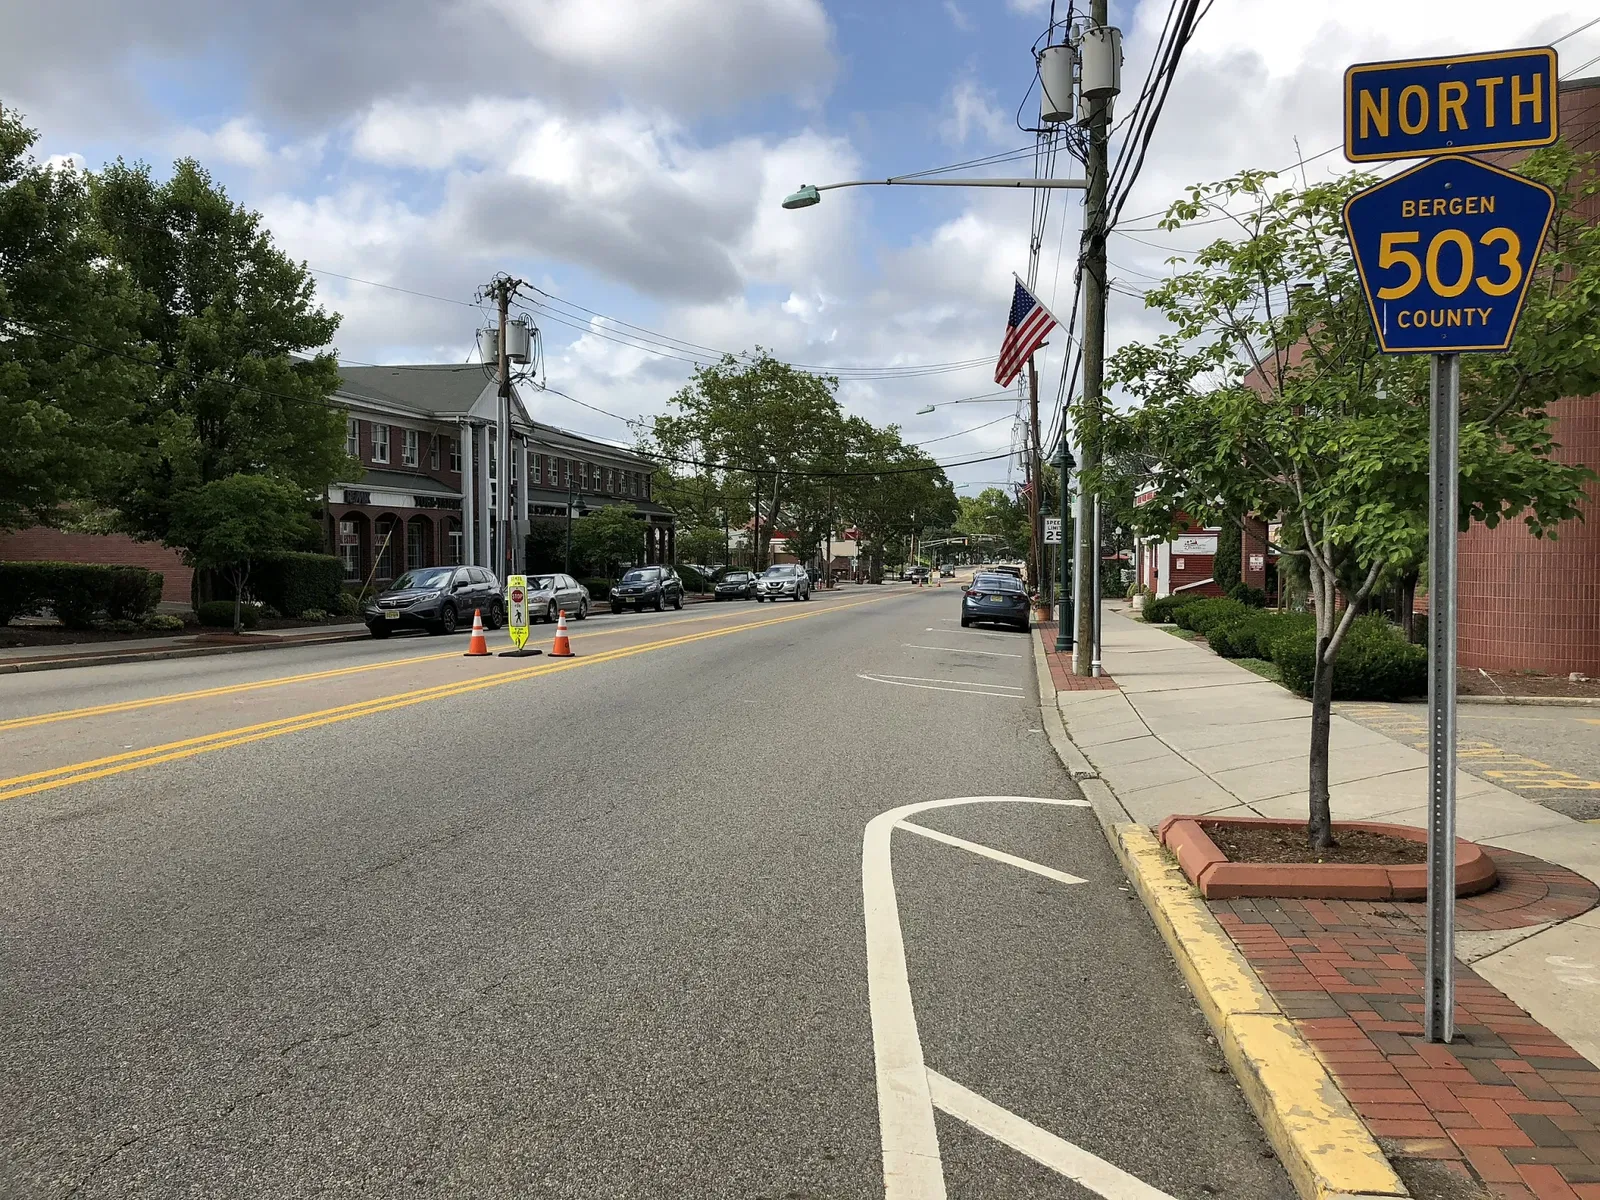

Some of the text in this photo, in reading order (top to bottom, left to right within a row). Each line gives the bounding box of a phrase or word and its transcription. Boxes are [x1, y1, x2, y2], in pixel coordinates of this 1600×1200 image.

[1359, 73, 1543, 139] NORTH
[1401, 195, 1495, 218] BERGEN
[1376, 227, 1522, 300] 503
[1397, 306, 1493, 328] COUNTY
[1046, 531, 1062, 541] 25
